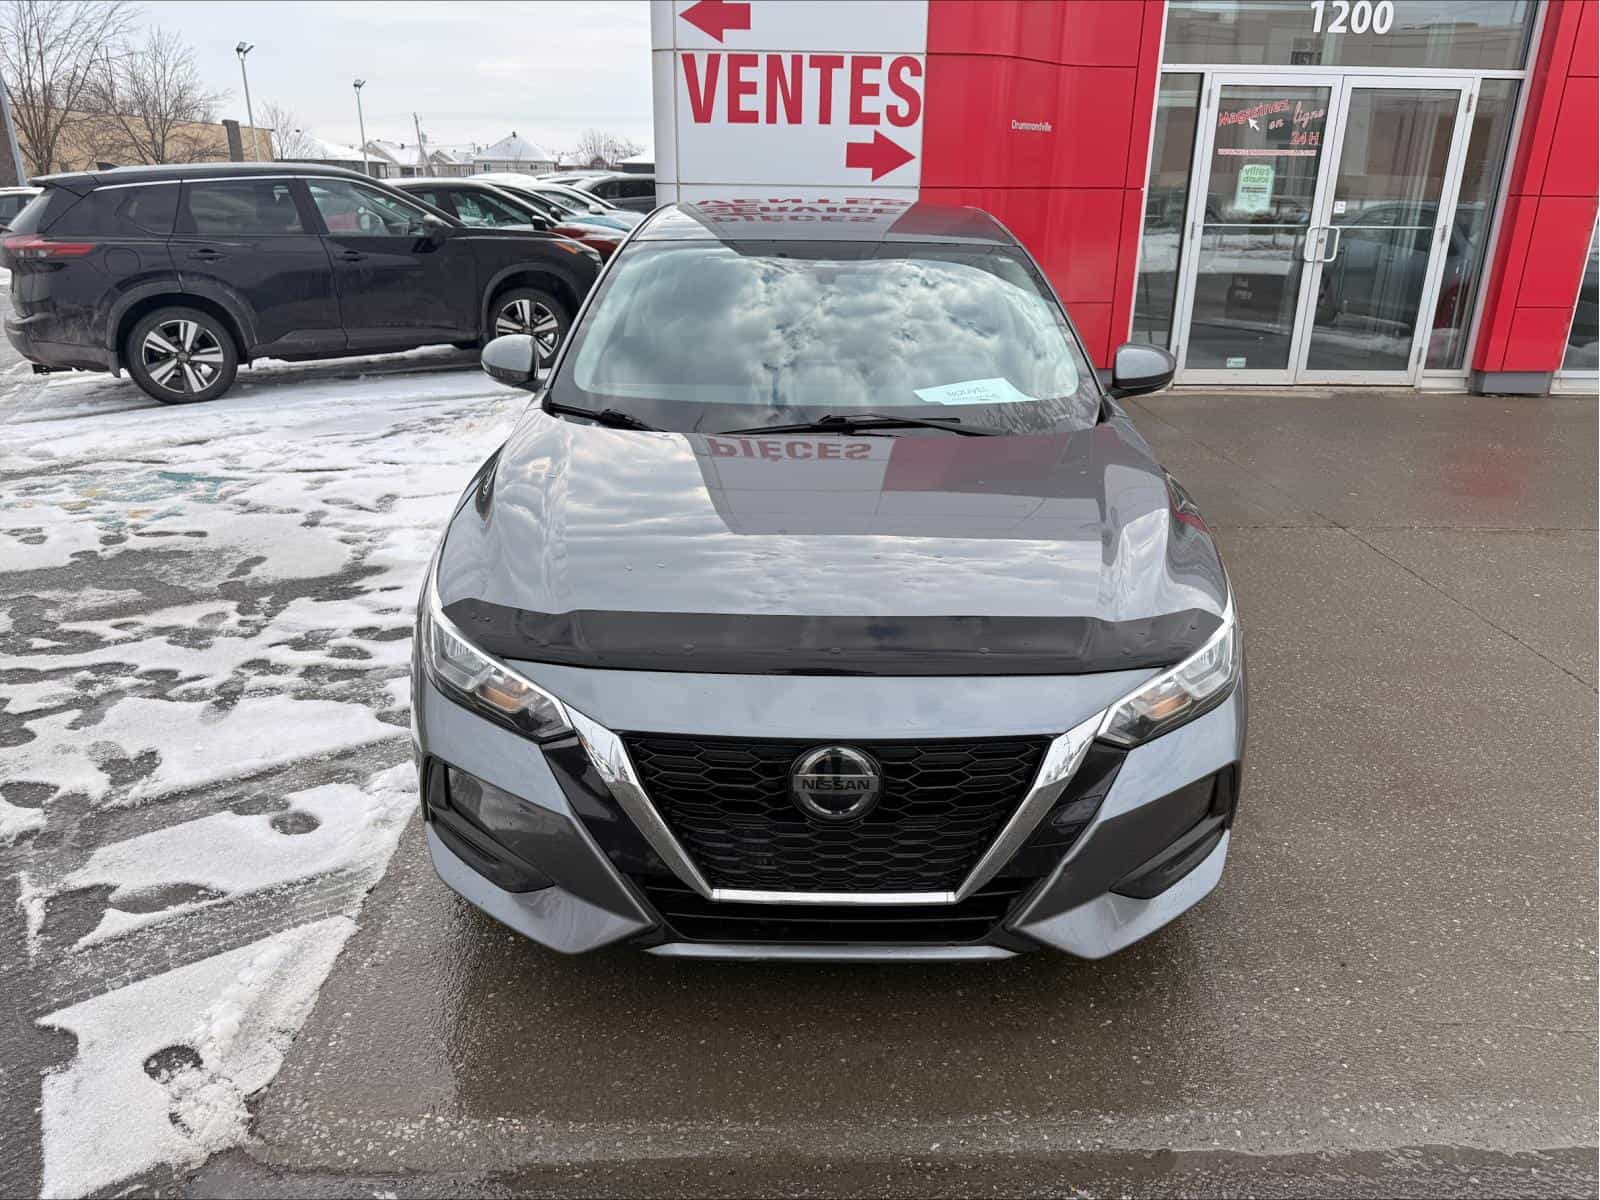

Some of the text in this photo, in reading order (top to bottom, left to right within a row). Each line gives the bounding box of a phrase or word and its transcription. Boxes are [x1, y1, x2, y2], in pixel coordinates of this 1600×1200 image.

[1311, 0, 1394, 34] 1200
[681, 53, 923, 128] VENTES
[802, 779, 870, 791] NISSAN
